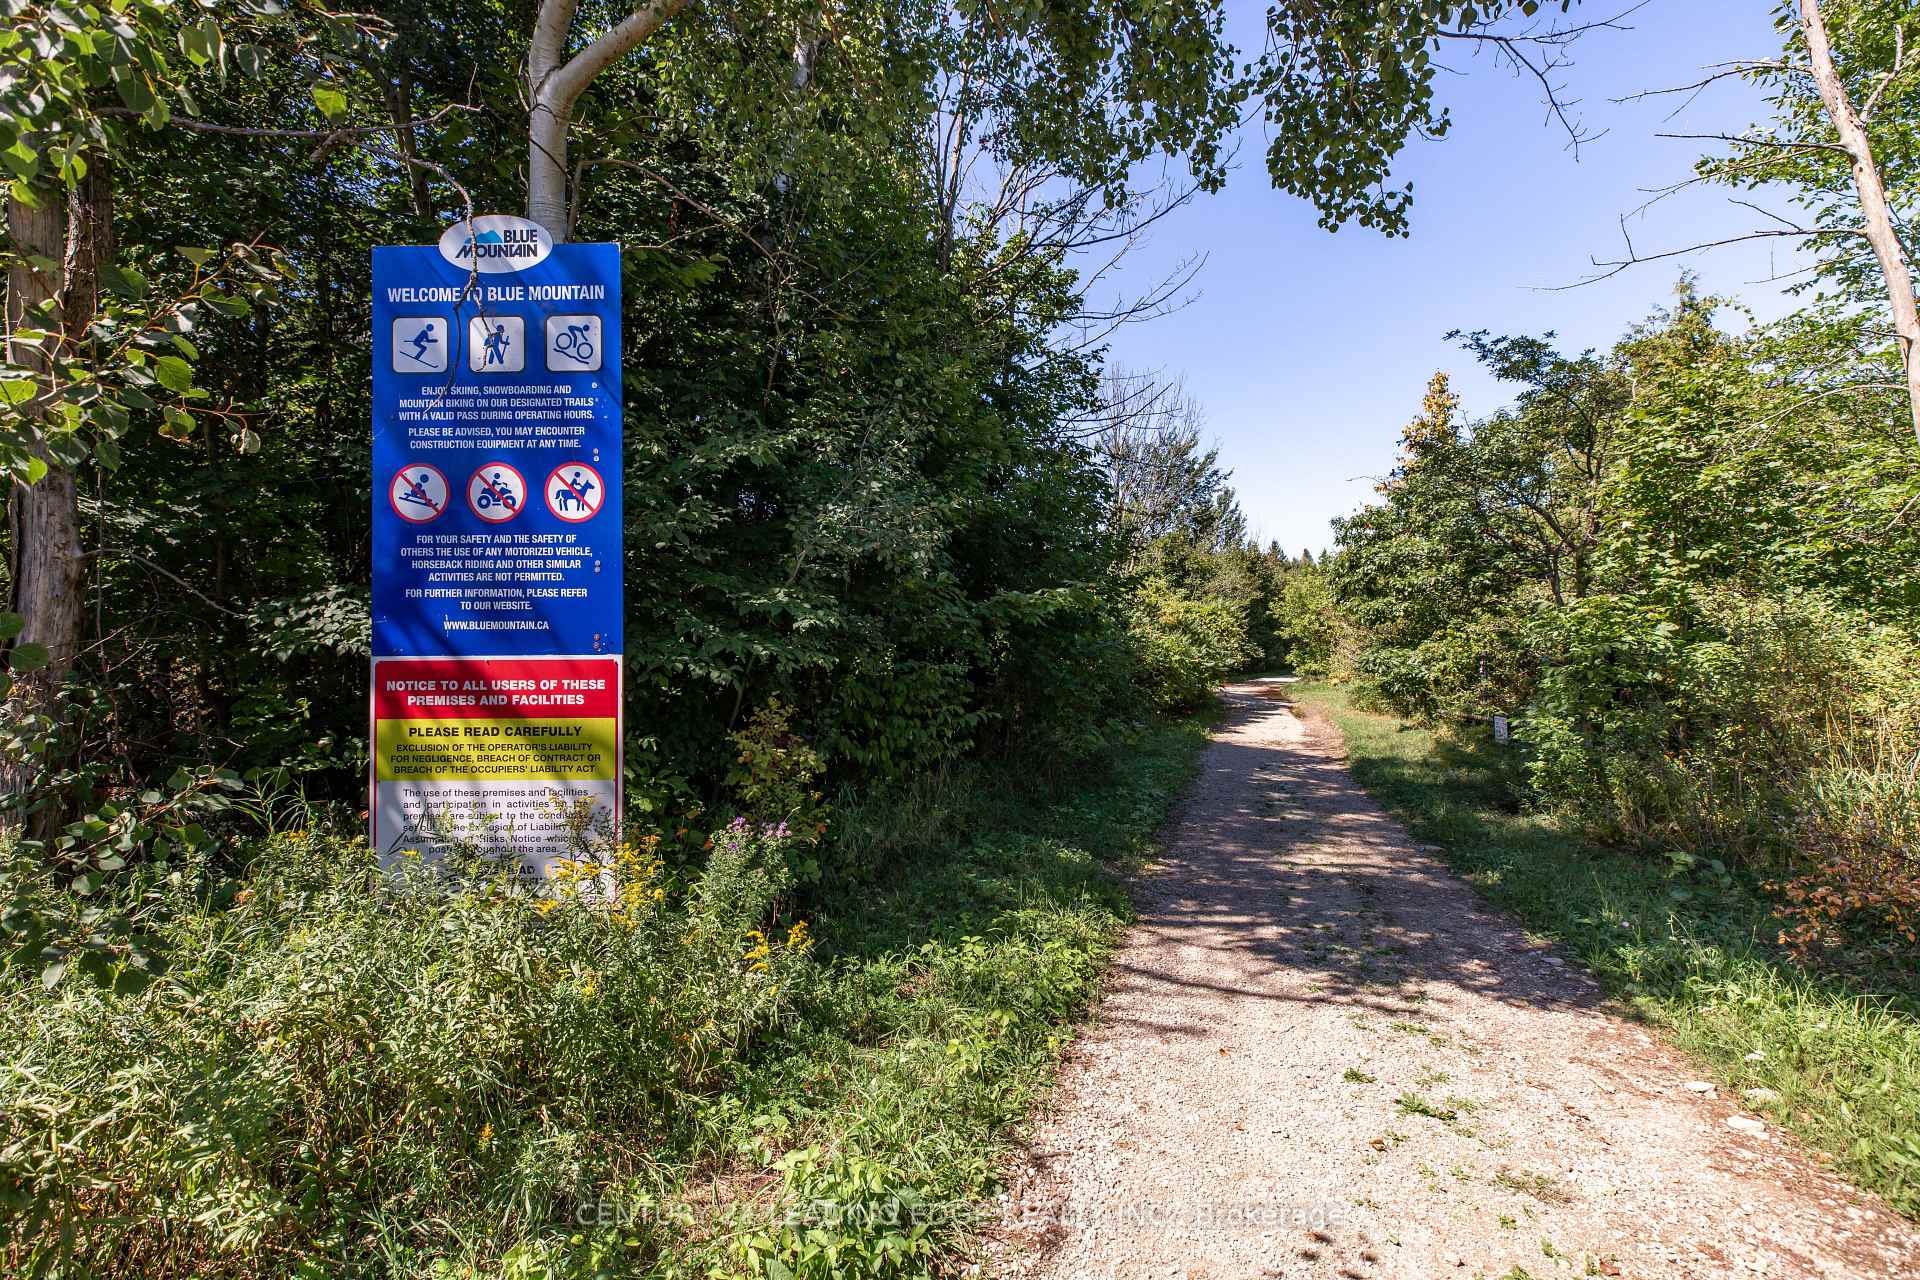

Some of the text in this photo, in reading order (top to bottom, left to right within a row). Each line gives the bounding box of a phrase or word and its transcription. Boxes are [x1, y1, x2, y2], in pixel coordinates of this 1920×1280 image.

[503, 229, 537, 243] BLUE
[455, 244, 538, 258] MOUNTAIN
[387, 288, 461, 302] WELCOME
[487, 286, 523, 301] BLUE
[528, 286, 604, 301] MOUNTAIN
[422, 386, 448, 396] ENJOY
[483, 386, 552, 395] SNOWBOARDING
[554, 385, 572, 394] AND
[446, 398, 475, 408] BIKING
[476, 398, 489, 407] ON
[490, 398, 509, 407] OUR
[510, 398, 562, 407] DESIGNATED
[564, 397, 594, 406] TRAILS
[399, 410, 595, 421] WITH A VALID PASS DURING OPERATING HOURS.
[408, 426, 585, 437] PLEASE BE ADVISED, YOU MAY ENCOUNTER
[410, 438, 582, 449] CONSTRUCTION EQUIPMENT AT ANY TIME.
[416, 534, 577, 544] FOR YOUR SAFETY AND THE SAFETY OF
[400, 547, 593, 557] OTHERS THE USE OF ANY MOTORIZED VEHICLE,
[412, 560, 581, 569] HORSEBACK RIDING AND OTHER SIMILAR
[428, 572, 565, 581] ACTIVITIES ARE NOT PERMITTED.
[405, 589, 588, 598] FOR FURTHER INFORMATION, PLEASE REFER
[460, 602, 533, 610] TO OUR WEBSITE.
[444, 621, 550, 630] WWW.BLUEMOUNTAIN.CA
[386, 680, 606, 691] NOTICE TO ALL USERS OF THESE
[408, 695, 585, 706] PREMISES AND FACILITIES
[408, 727, 582, 737] PLEASE READ CAREFULLY
[396, 743, 593, 752] EXCLUSION OF THE OPERATOR'S LIABILITY
[390, 755, 410, 763] FOR
[477, 755, 515, 763] BREACH
[518, 754, 531, 763] OF
[533, 754, 585, 763] CONTRACT
[587, 754, 601, 762] OR
[394, 765, 432, 774] BREACH
[434, 765, 448, 774] OF
[450, 765, 468, 774] THE
[530, 765, 574, 773] LIABILITY
[576, 765, 595, 773] ACT
[403, 789, 421, 797] The
[442, 789, 452, 797] of
[454, 789, 480, 797] these
[482, 788, 526, 798] premises
[528, 788, 546, 797] and
[403, 801, 421, 809] and
[427, 800, 487, 810] partcipaton
[492, 800, 501, 808] in
[507, 800, 550, 808] activities
[520, 812, 535, 820] the
[518, 823, 529, 831] of
[511, 834, 541, 843] Notice
[518, 845, 533, 853] the
